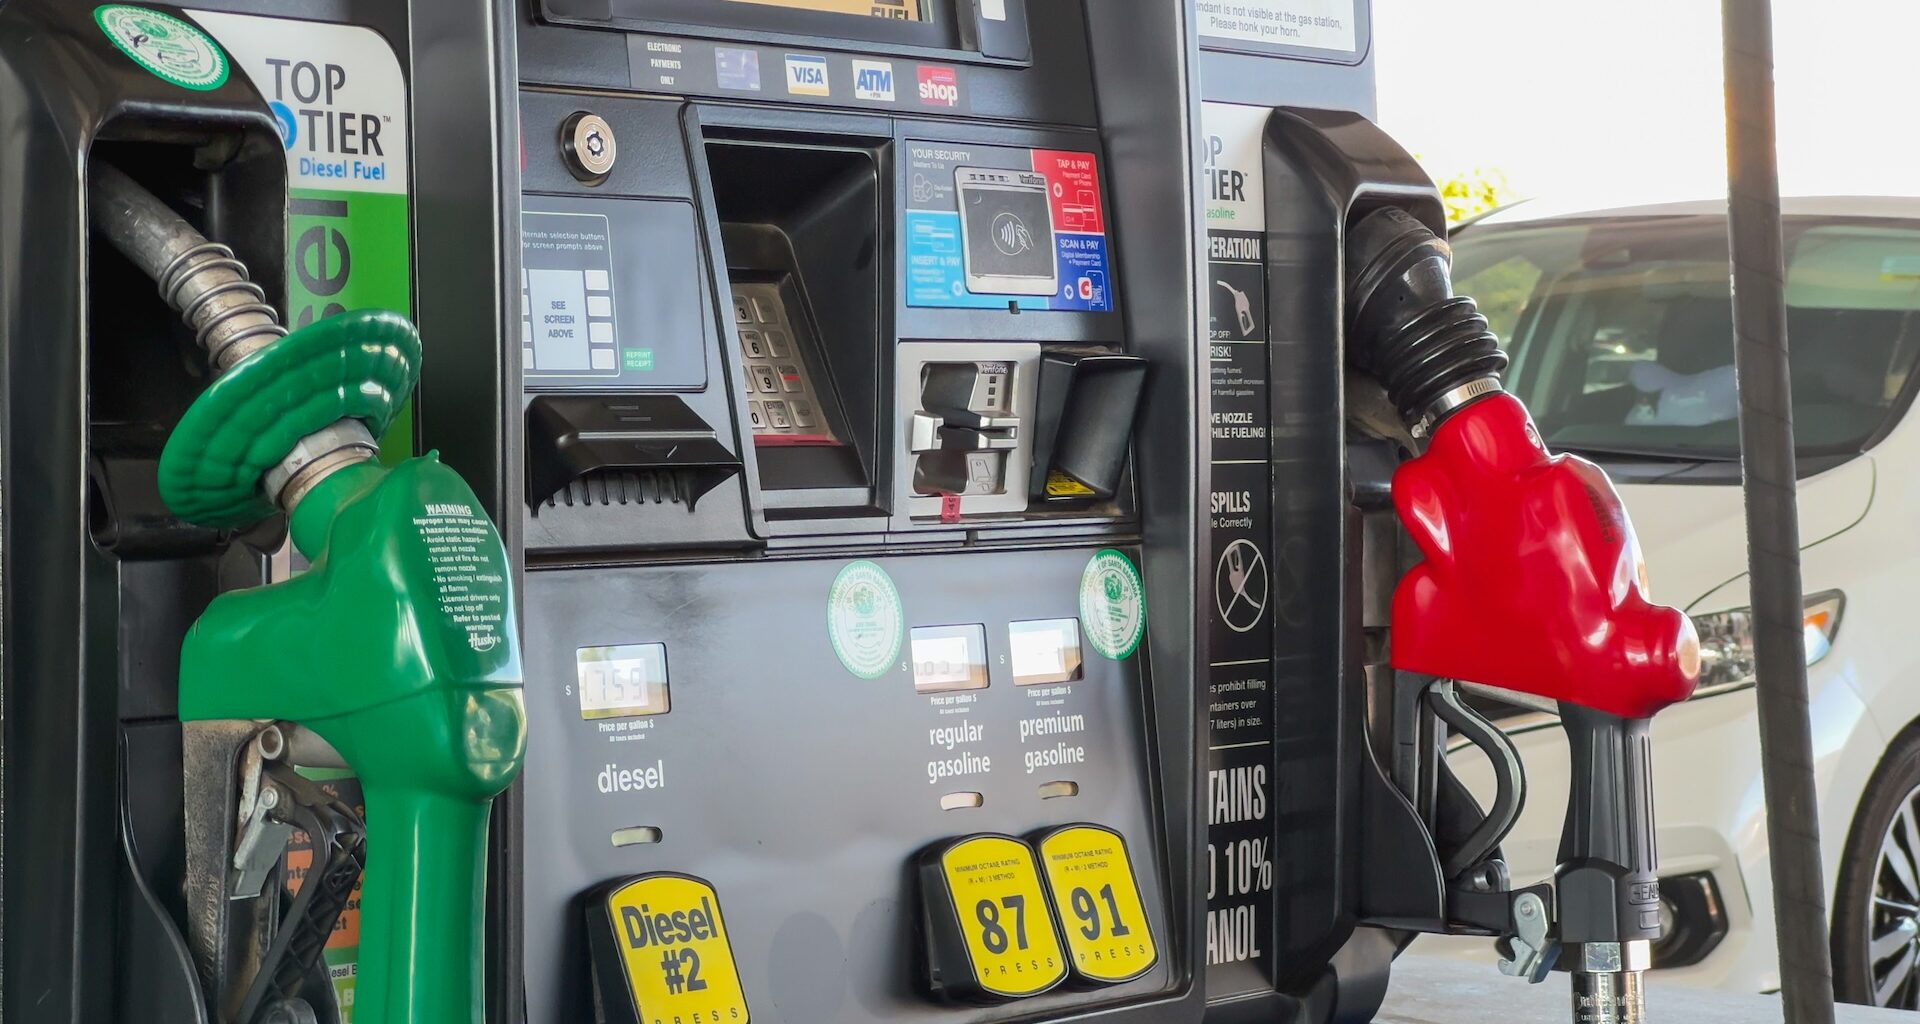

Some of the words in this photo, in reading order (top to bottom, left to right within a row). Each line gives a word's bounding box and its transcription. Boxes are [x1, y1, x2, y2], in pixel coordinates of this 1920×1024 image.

[1223, 6, 1231, 15] is
[1233, 6, 1245, 17] not
[1248, 8, 1273, 20] visible
[1275, 11, 1282, 21] at
[1284, 12, 1296, 23] the
[1299, 15, 1312, 26] gas
[1314, 16, 1342, 30] station,
[1210, 17, 1237, 30] Please
[1239, 20, 1258, 32] honk
[1261, 24, 1278, 36] your
[1280, 25, 1300, 37] horn.
[647, 42, 681, 53] ELECTRONIC
[650, 58, 681, 70] PAYMENTS
[265, 58, 346, 105] TOP
[660, 75, 674, 85] ONLY
[792, 66, 823, 85] VISA
[856, 69, 891, 92] ATM
[919, 80, 958, 106] shop
[299, 109, 384, 156] TIER
[912, 148, 934, 159] YOUR
[935, 150, 971, 161] SECURITY
[300, 157, 347, 178] Diesel
[354, 161, 385, 180] Fuel
[1056, 159, 1070, 168] TAP
[1071, 160, 1076, 169] &
[1077, 160, 1090, 170] PAY
[580, 232, 604, 240] buttons
[556, 243, 582, 251] prompts
[1060, 239, 1080, 249] SCAN
[1080, 240, 1085, 249] &
[1086, 240, 1099, 250] PAY
[551, 301, 566, 309] SEE
[544, 315, 575, 324] SCREEN
[739, 307, 747, 320] 3
[548, 329, 574, 338] ABOVE
[751, 342, 759, 354] 6
[1211, 346, 1231, 357] RISK!
[764, 377, 772, 389] 9
[751, 412, 759, 424] 0
[1222, 412, 1253, 423] NOZZLE
[1231, 427, 1266, 438] FUELING!
[1211, 491, 1251, 513] SPILLS
[425, 504, 473, 515] WARNING
[413, 517, 443, 526] Improper
[458, 518, 470, 526] may
[1219, 517, 1253, 529] Correctly
[437, 575, 446, 583] No
[447, 575, 473, 583] smoking
[442, 595, 469, 603] Licensed
[489, 594, 500, 603] only
[465, 604, 475, 612] top
[480, 614, 501, 622] posted
[465, 624, 494, 632] warnings
[468, 632, 496, 650] Husky
[1028, 688, 1041, 697] Price
[1042, 688, 1050, 697] per
[1051, 687, 1066, 696] gallon
[1218, 680, 1246, 695] prohibit
[1246, 678, 1266, 691] filling
[931, 697, 944, 706] Price
[946, 696, 954, 705] per
[956, 695, 972, 704] gallon
[1210, 701, 1239, 712] ntainers
[1240, 700, 1257, 710] over
[599, 722, 615, 732] Price
[617, 722, 627, 731] per
[629, 720, 648, 730] gallon
[1020, 710, 1084, 743] premium
[1216, 717, 1237, 730] liters)
[1238, 717, 1245, 727] in
[1246, 716, 1263, 727] size.
[929, 720, 983, 750] regular
[1025, 743, 1084, 773] gasoline
[928, 752, 991, 784] gasoline
[598, 760, 664, 794] diesel
[1208, 764, 1266, 826] TAINS
[1052, 853, 1074, 861] MINIMUM
[1074, 850, 1094, 858] OCTANE
[1095, 848, 1113, 856] RATING
[955, 864, 978, 872] MINIMUM
[979, 861, 1000, 870] OCTANE
[1001, 859, 1020, 867] RATING
[1225, 836, 1272, 896] 10%
[994, 873, 1015, 881] METHOD
[1071, 884, 1130, 941] 91
[621, 896, 718, 949] Diesel
[976, 895, 1028, 954] 87
[1206, 904, 1261, 966] ANOL
[1080, 944, 1145, 963] PRESS
[661, 948, 707, 995] #2
[984, 958, 1054, 977] PRESS
